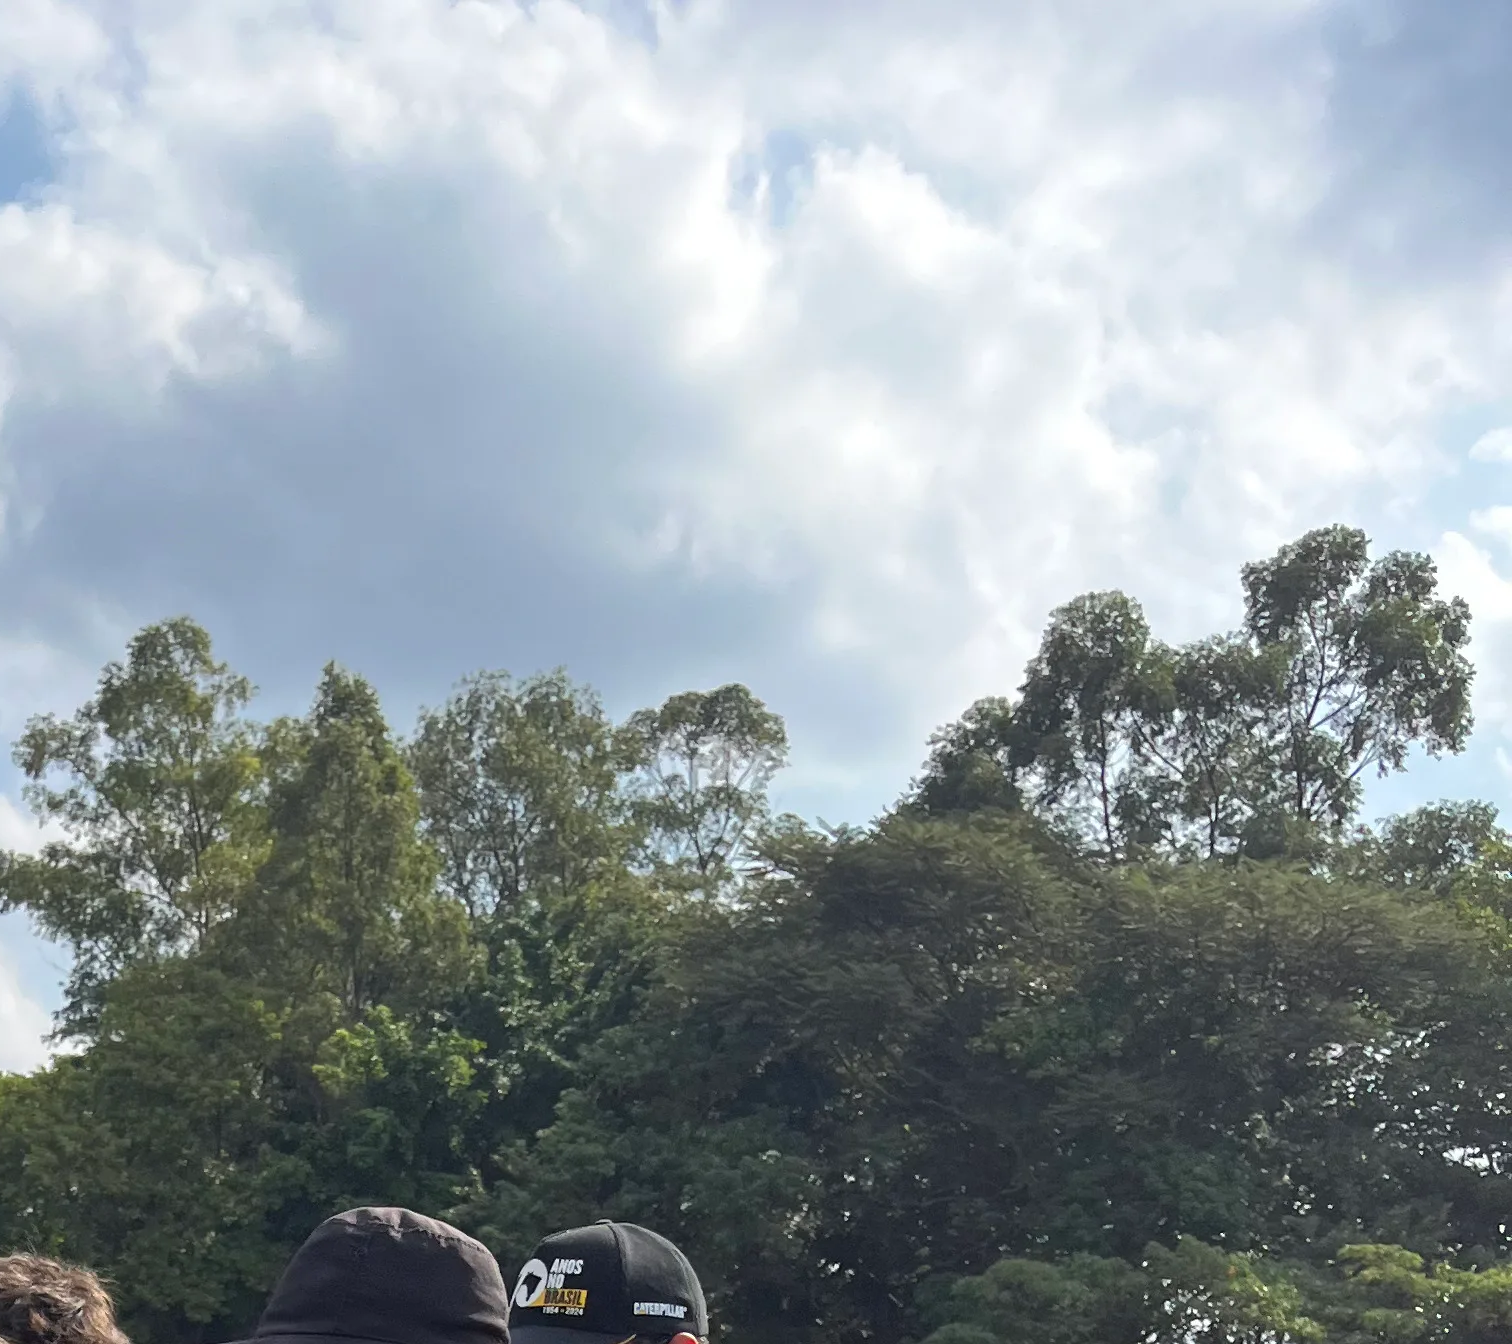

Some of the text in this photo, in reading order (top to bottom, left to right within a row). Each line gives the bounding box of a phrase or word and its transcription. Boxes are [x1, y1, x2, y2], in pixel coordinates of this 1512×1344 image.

[550, 1258, 584, 1275] ANOS
[547, 1273, 565, 1289] NO
[544, 1289, 583, 1306] BRASIL
